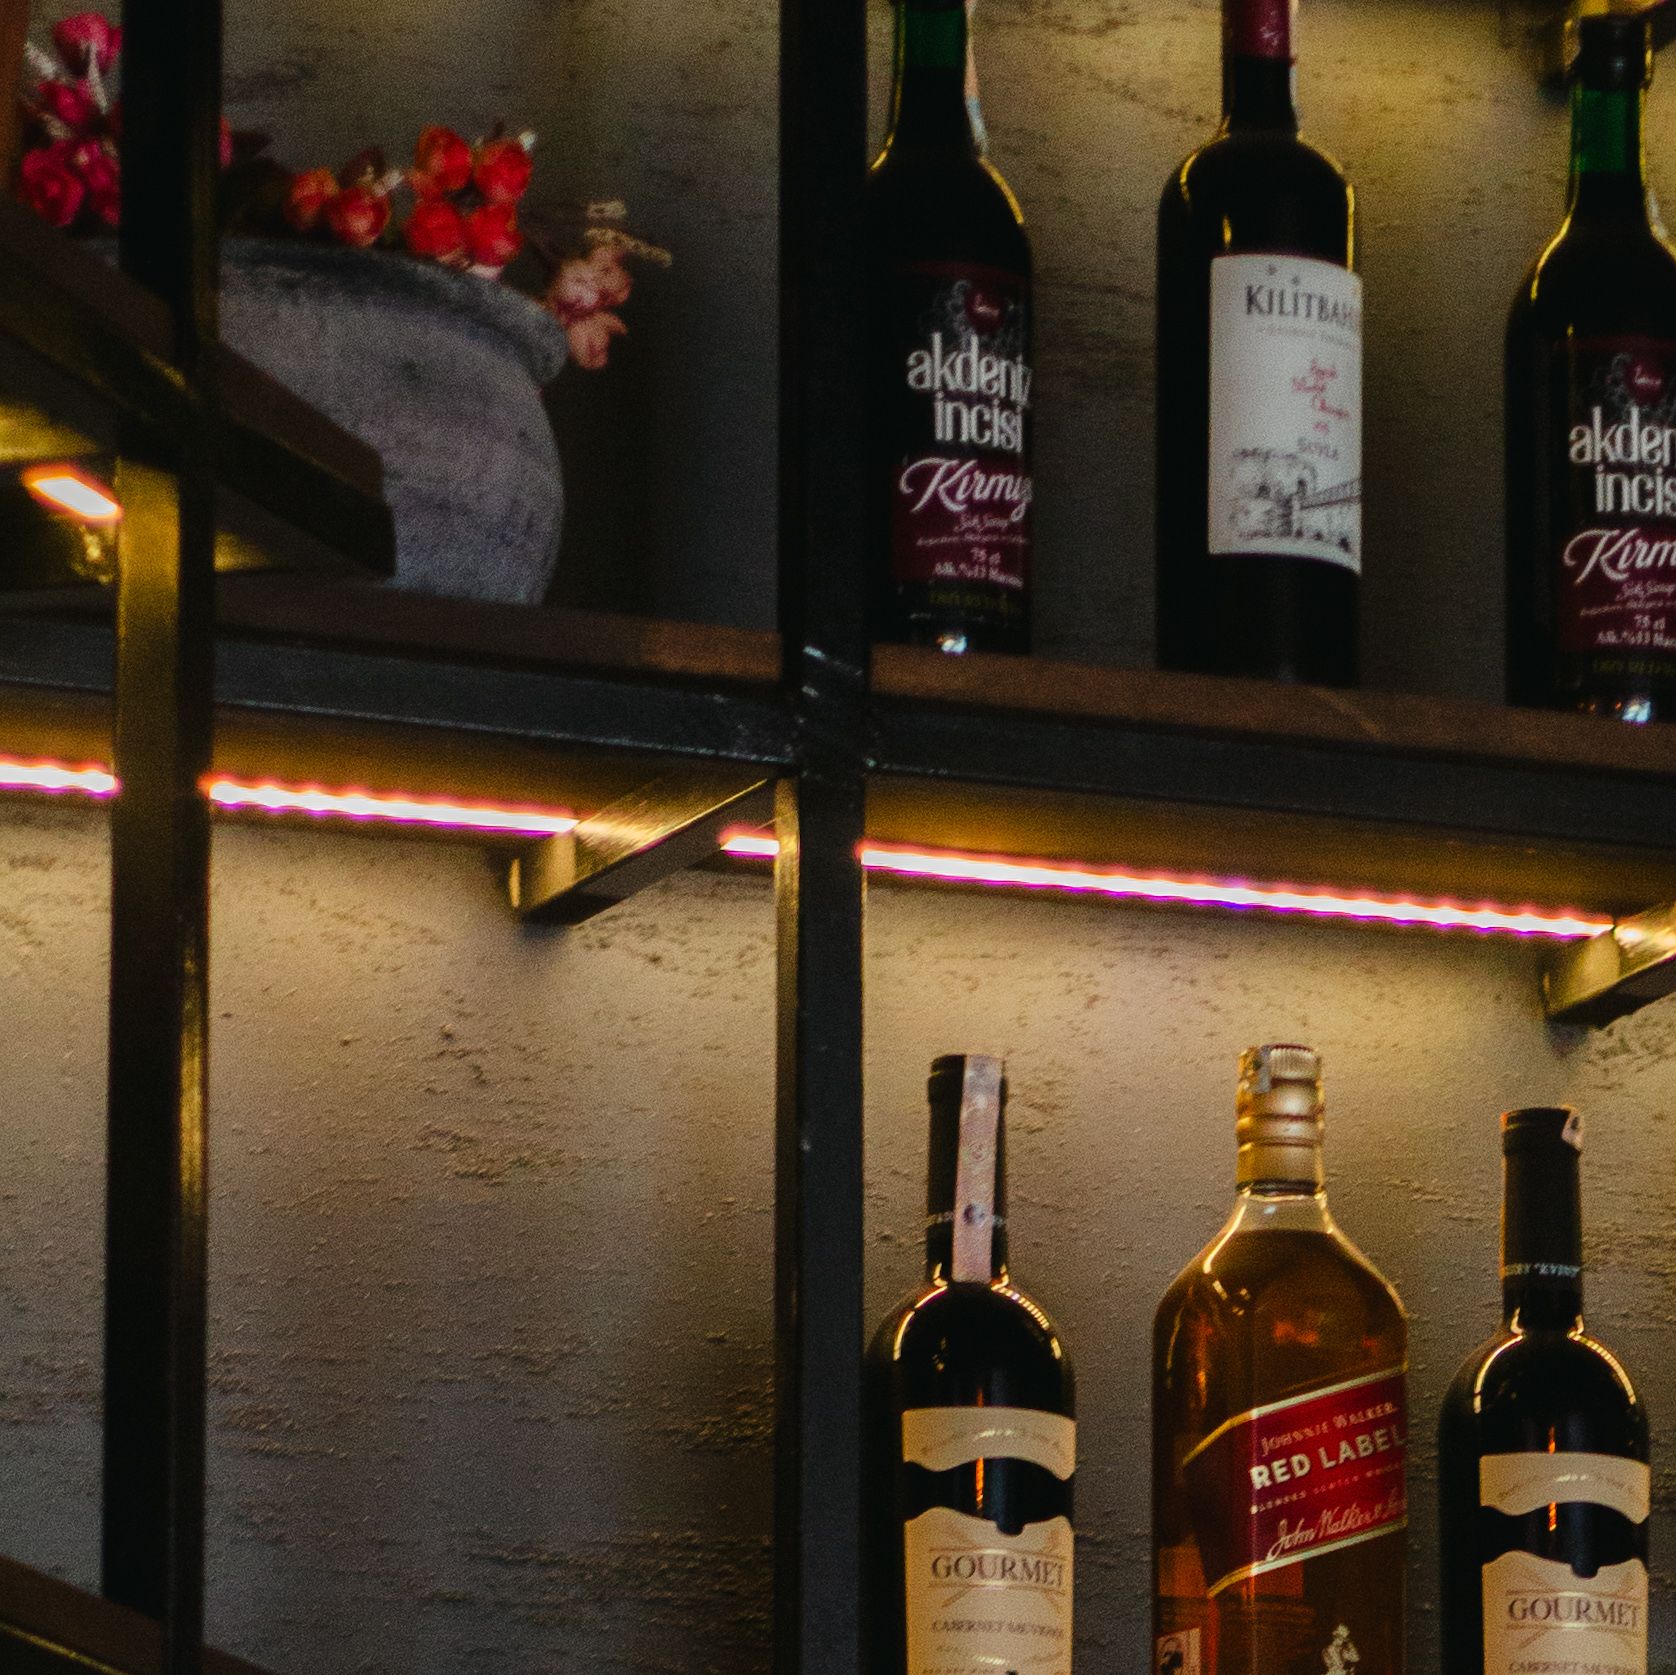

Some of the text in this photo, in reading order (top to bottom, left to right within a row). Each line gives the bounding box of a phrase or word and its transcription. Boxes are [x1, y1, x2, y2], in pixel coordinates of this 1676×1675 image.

[906, 331, 1033, 408] akdeniz
[933, 391, 1024, 453] incisi
[1249, 1452, 1312, 1491] RED
[1318, 1424, 1406, 1470] LABEL
[1265, 1518, 1316, 1562] John
[931, 1553, 1064, 1588] GOURMET
[1508, 1597, 1640, 1629] GOURMET
